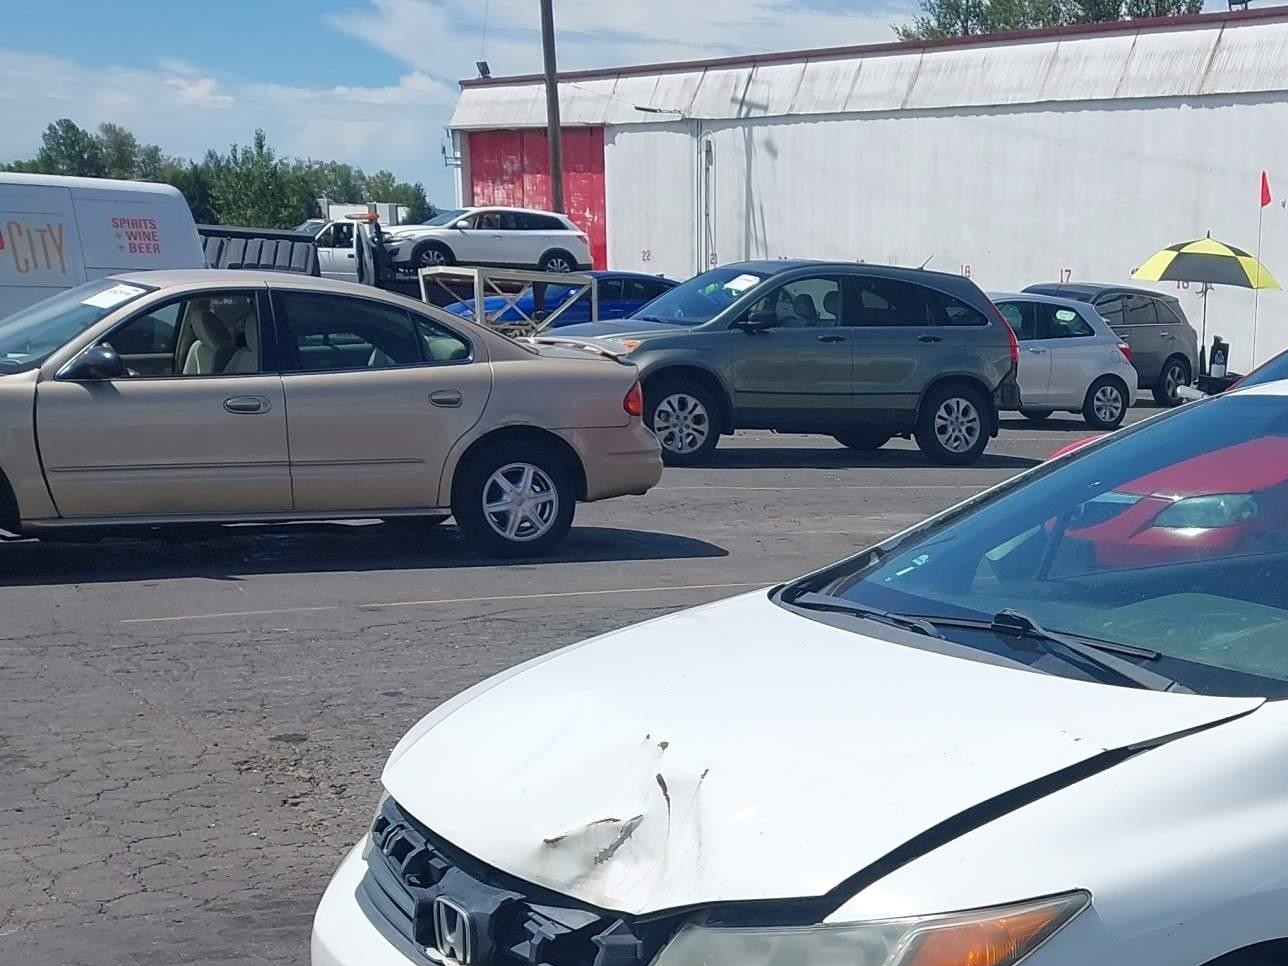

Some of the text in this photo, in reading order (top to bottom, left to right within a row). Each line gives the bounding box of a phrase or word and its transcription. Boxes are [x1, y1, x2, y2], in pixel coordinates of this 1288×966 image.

[111, 217, 157, 229] SPIRITS
[125, 231, 158, 242] WINE
[6, 220, 67, 274] CITY
[129, 243, 161, 254] BEER
[641, 250, 651, 262] 22
[1060, 268, 1072, 283] 17
